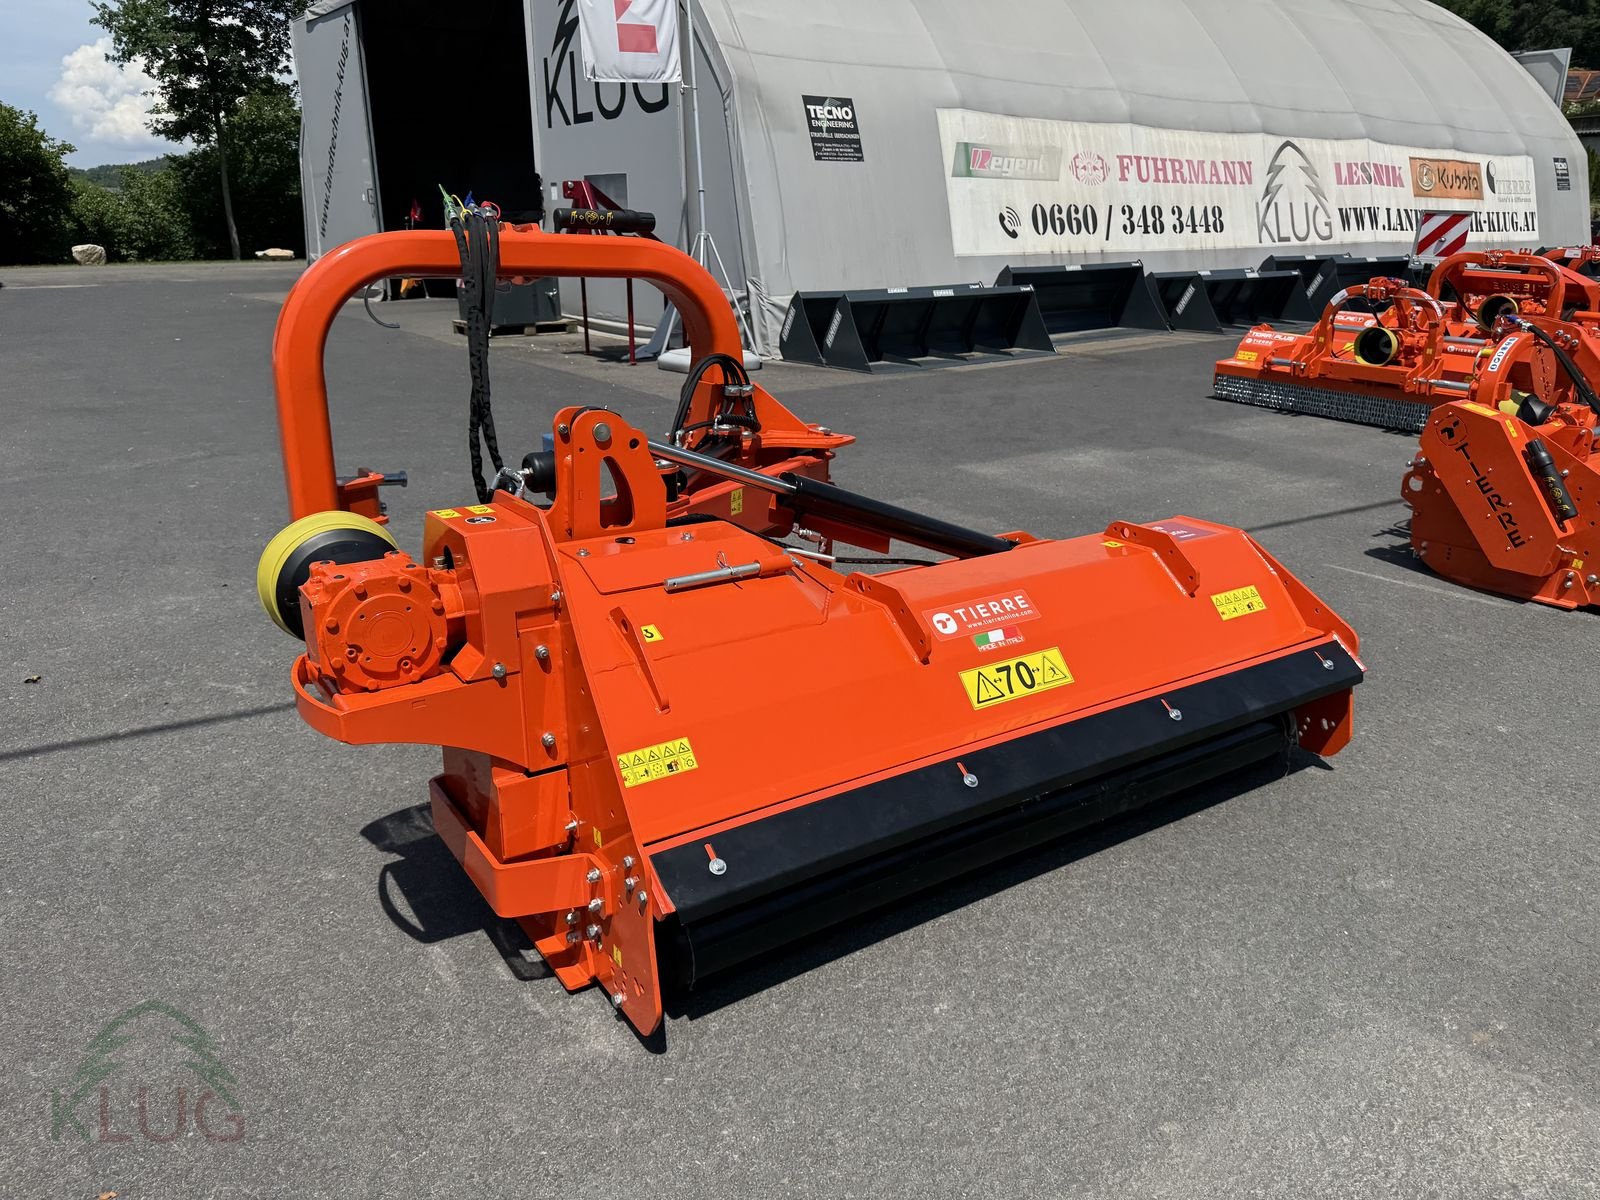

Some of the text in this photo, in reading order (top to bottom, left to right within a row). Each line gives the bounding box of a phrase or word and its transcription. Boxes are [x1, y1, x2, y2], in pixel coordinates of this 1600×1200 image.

[320, 13, 351, 239] www.landtechnik-klug.at
[806, 105, 853, 120] TECNO
[811, 119, 854, 129] ENGINEERING
[969, 147, 1048, 177] Regent
[1116, 154, 1253, 185] FUHRMANN
[1334, 161, 1405, 188] LESNIK
[1437, 166, 1479, 191] Kubota
[1031, 203, 1225, 241] 0660 / 348 3448
[1256, 201, 1333, 244] KLUG
[1455, 442, 1526, 549] TIERRE
[954, 595, 1029, 622] TIERRE
[967, 609, 1034, 629] www.tierreonline.com
[978, 642, 998, 652] MADE
[1006, 635, 1025, 646] ITALY
[995, 661, 1036, 695] 70
